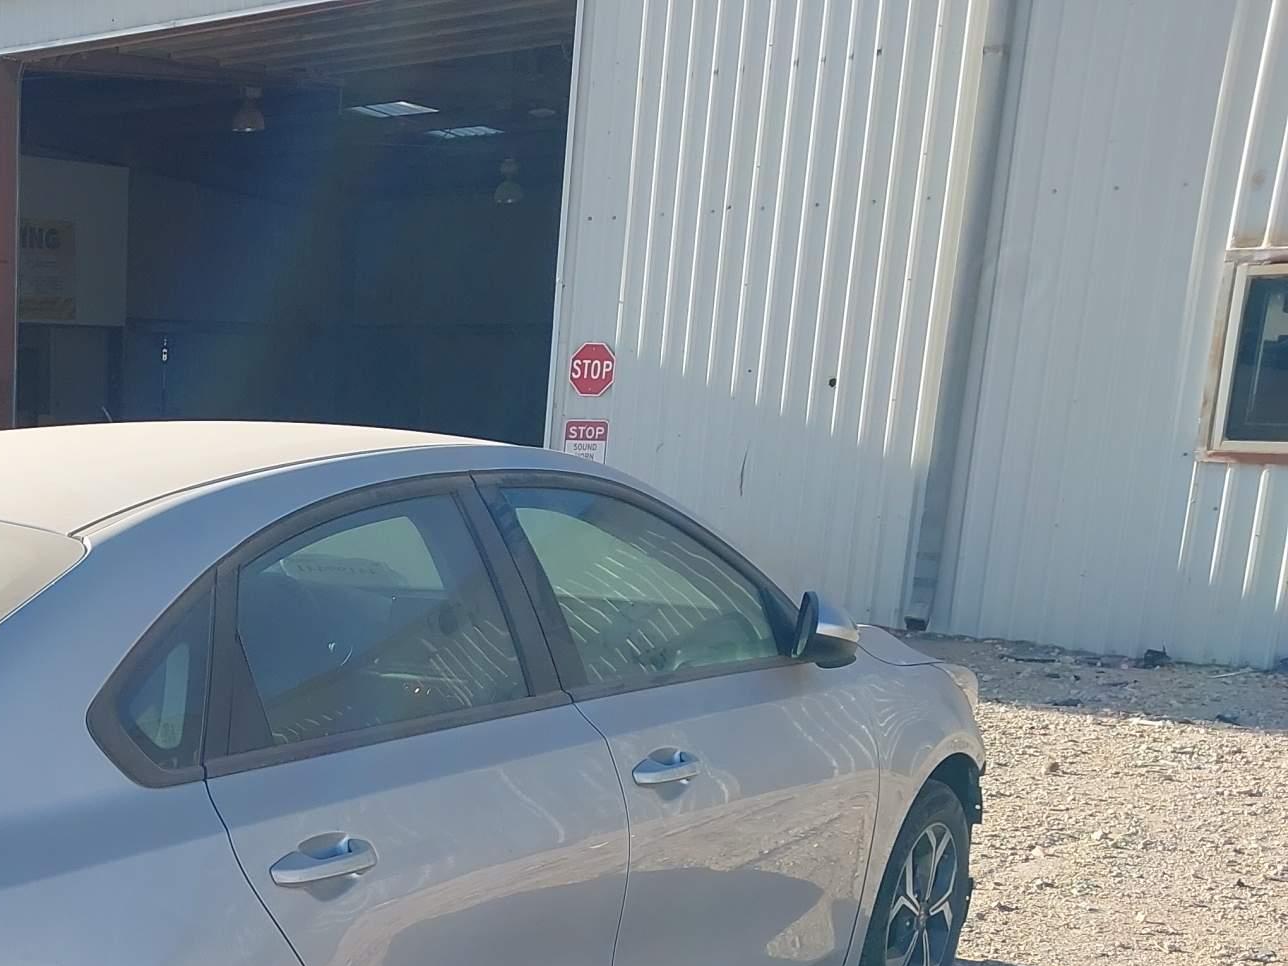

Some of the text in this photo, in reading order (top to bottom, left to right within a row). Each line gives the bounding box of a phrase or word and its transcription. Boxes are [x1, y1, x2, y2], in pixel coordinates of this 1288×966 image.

[571, 359, 613, 380] STOP
[568, 426, 605, 440] STOP
[573, 443, 598, 451] SOUND
